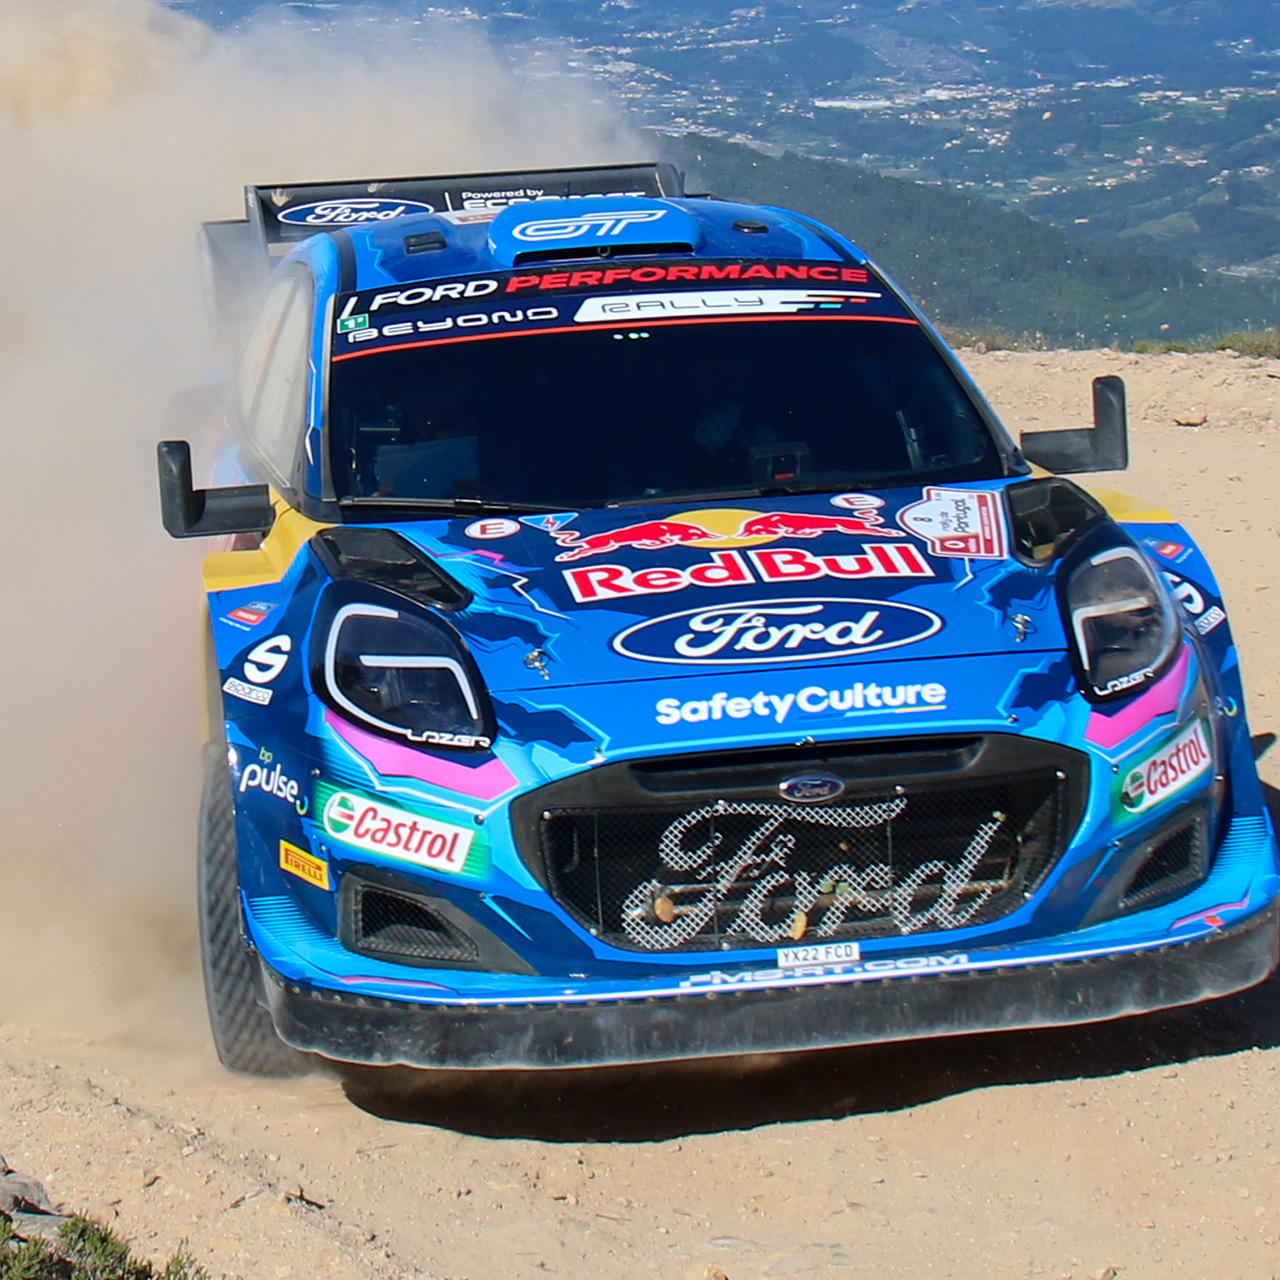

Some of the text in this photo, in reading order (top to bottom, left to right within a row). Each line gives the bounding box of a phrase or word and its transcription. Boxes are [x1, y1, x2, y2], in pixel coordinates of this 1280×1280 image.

[306, 203, 407, 223] Ford
[461, 188, 544, 200] Powered by
[369, 264, 869, 311] FORD PERFORMANCE
[348, 297, 763, 343] BEYOND RALLY
[950, 498, 971, 534] Portugal
[566, 544, 932, 601] Red Bull
[674, 604, 884, 657] Ford
[227, 680, 270, 701] sparco
[655, 682, 947, 725] SafetyCulture
[259, 747, 274, 763] bp
[406, 729, 491, 748] LAZER
[1146, 727, 1207, 795] Castrol
[239, 763, 299, 803] pulse
[353, 807, 460, 863] Castrol
[285, 847, 323, 882] PIRELLI
[621, 795, 1006, 950] Ford
[782, 944, 852, 963] YX22 FCD
